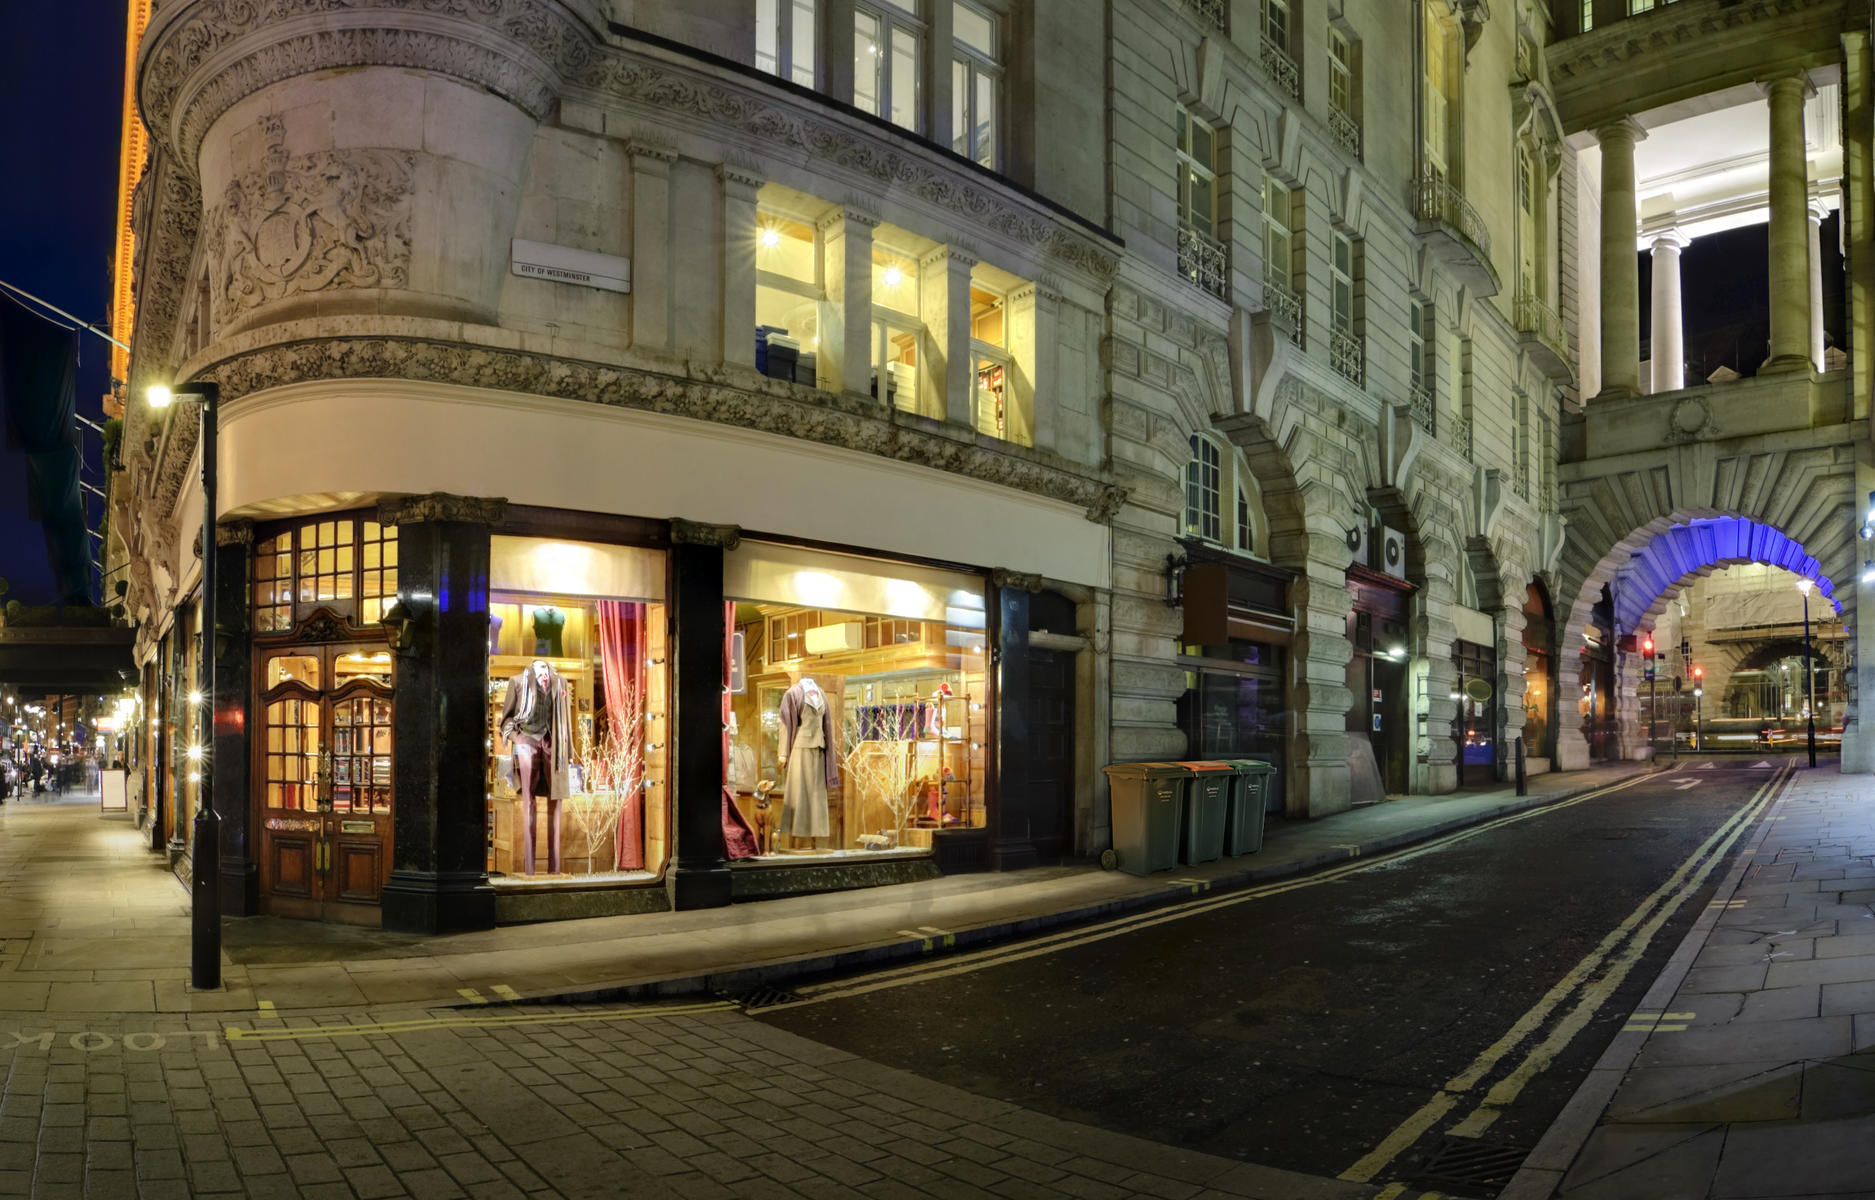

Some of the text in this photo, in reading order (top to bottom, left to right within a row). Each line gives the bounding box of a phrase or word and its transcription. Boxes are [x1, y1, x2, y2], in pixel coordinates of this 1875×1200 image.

[521, 264, 591, 281] CITY OF WESTMINSTER
[2, 1031, 220, 1051] LOOK
